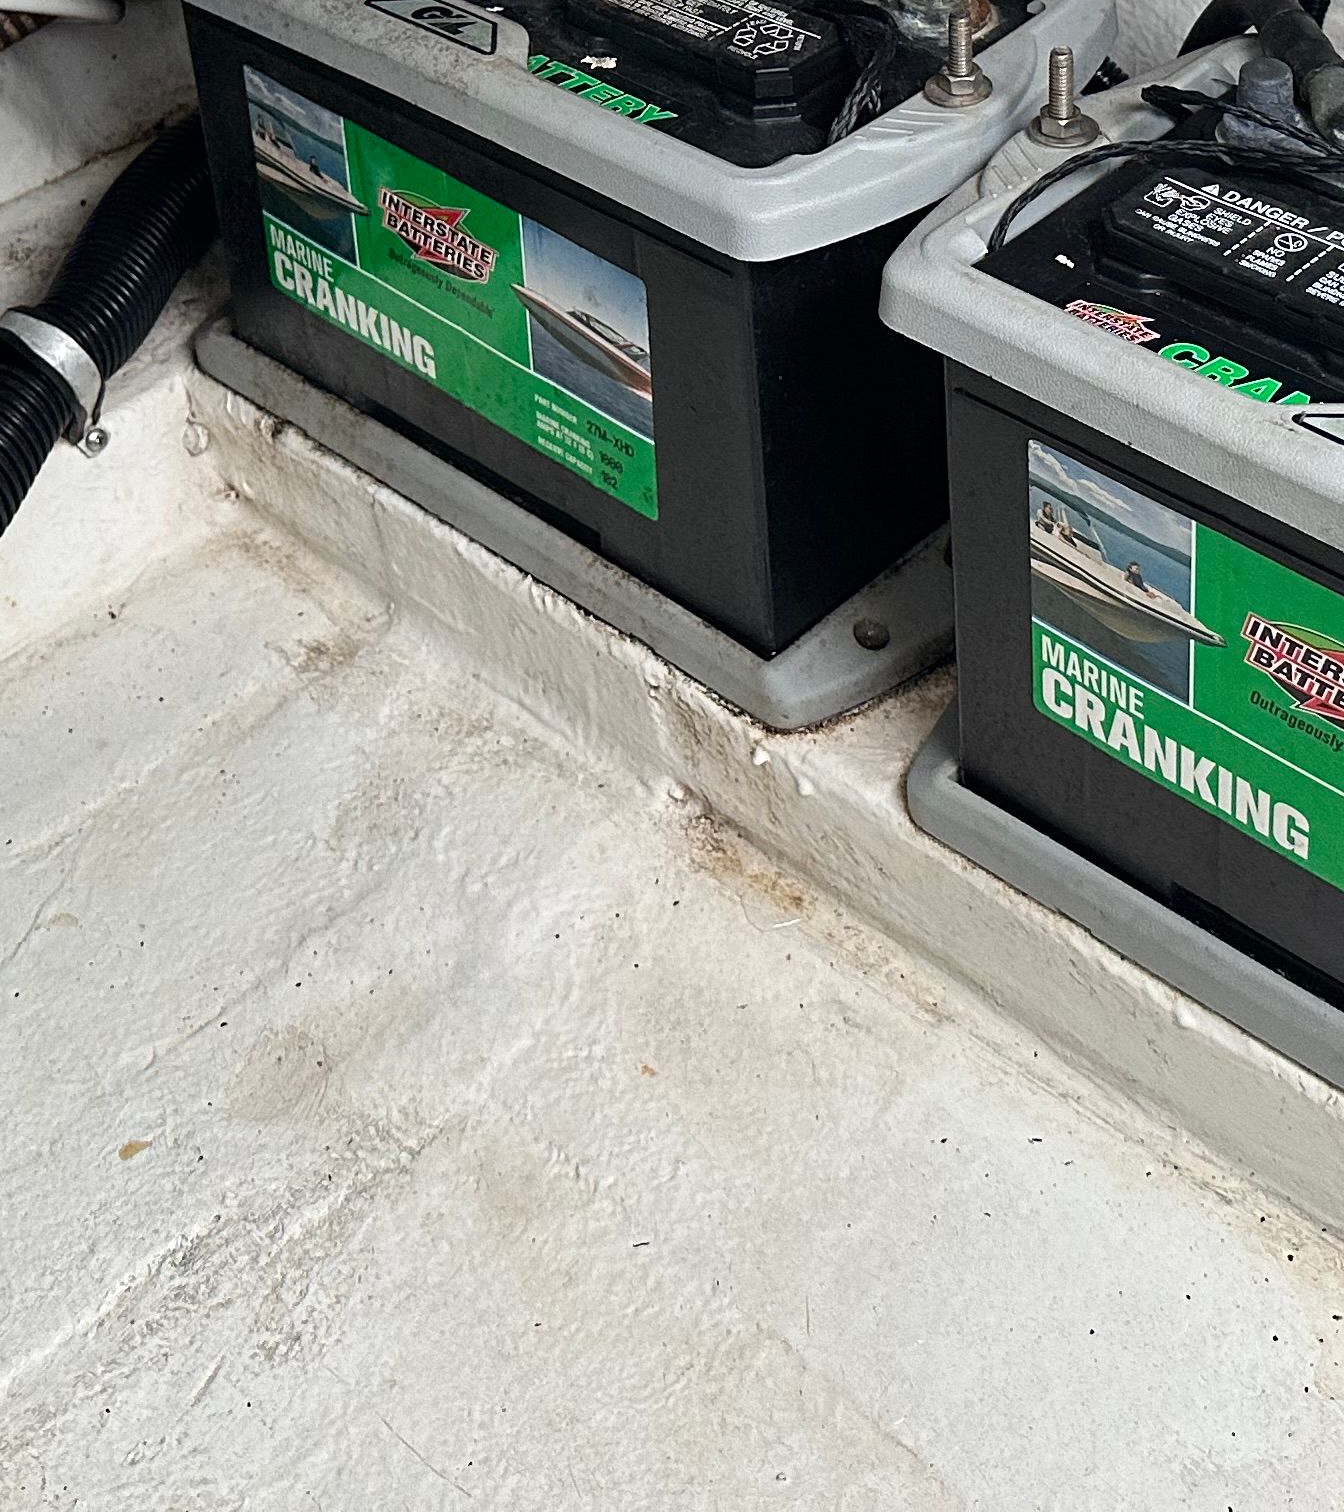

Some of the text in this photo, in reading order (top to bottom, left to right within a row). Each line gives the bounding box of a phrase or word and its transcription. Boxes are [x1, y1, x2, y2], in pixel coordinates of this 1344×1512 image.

[381, 191, 492, 263] INTERSTATE
[1222, 190, 1310, 230] DANGER
[269, 224, 334, 282] MARINE
[387, 215, 486, 280] BATTERIES
[1265, 247, 1286, 257] NO
[273, 250, 437, 379] CRANKING
[1041, 633, 1145, 720] MARINE
[1249, 690, 1344, 752] Outrageously
[1042, 666, 1310, 860] CRANKING
